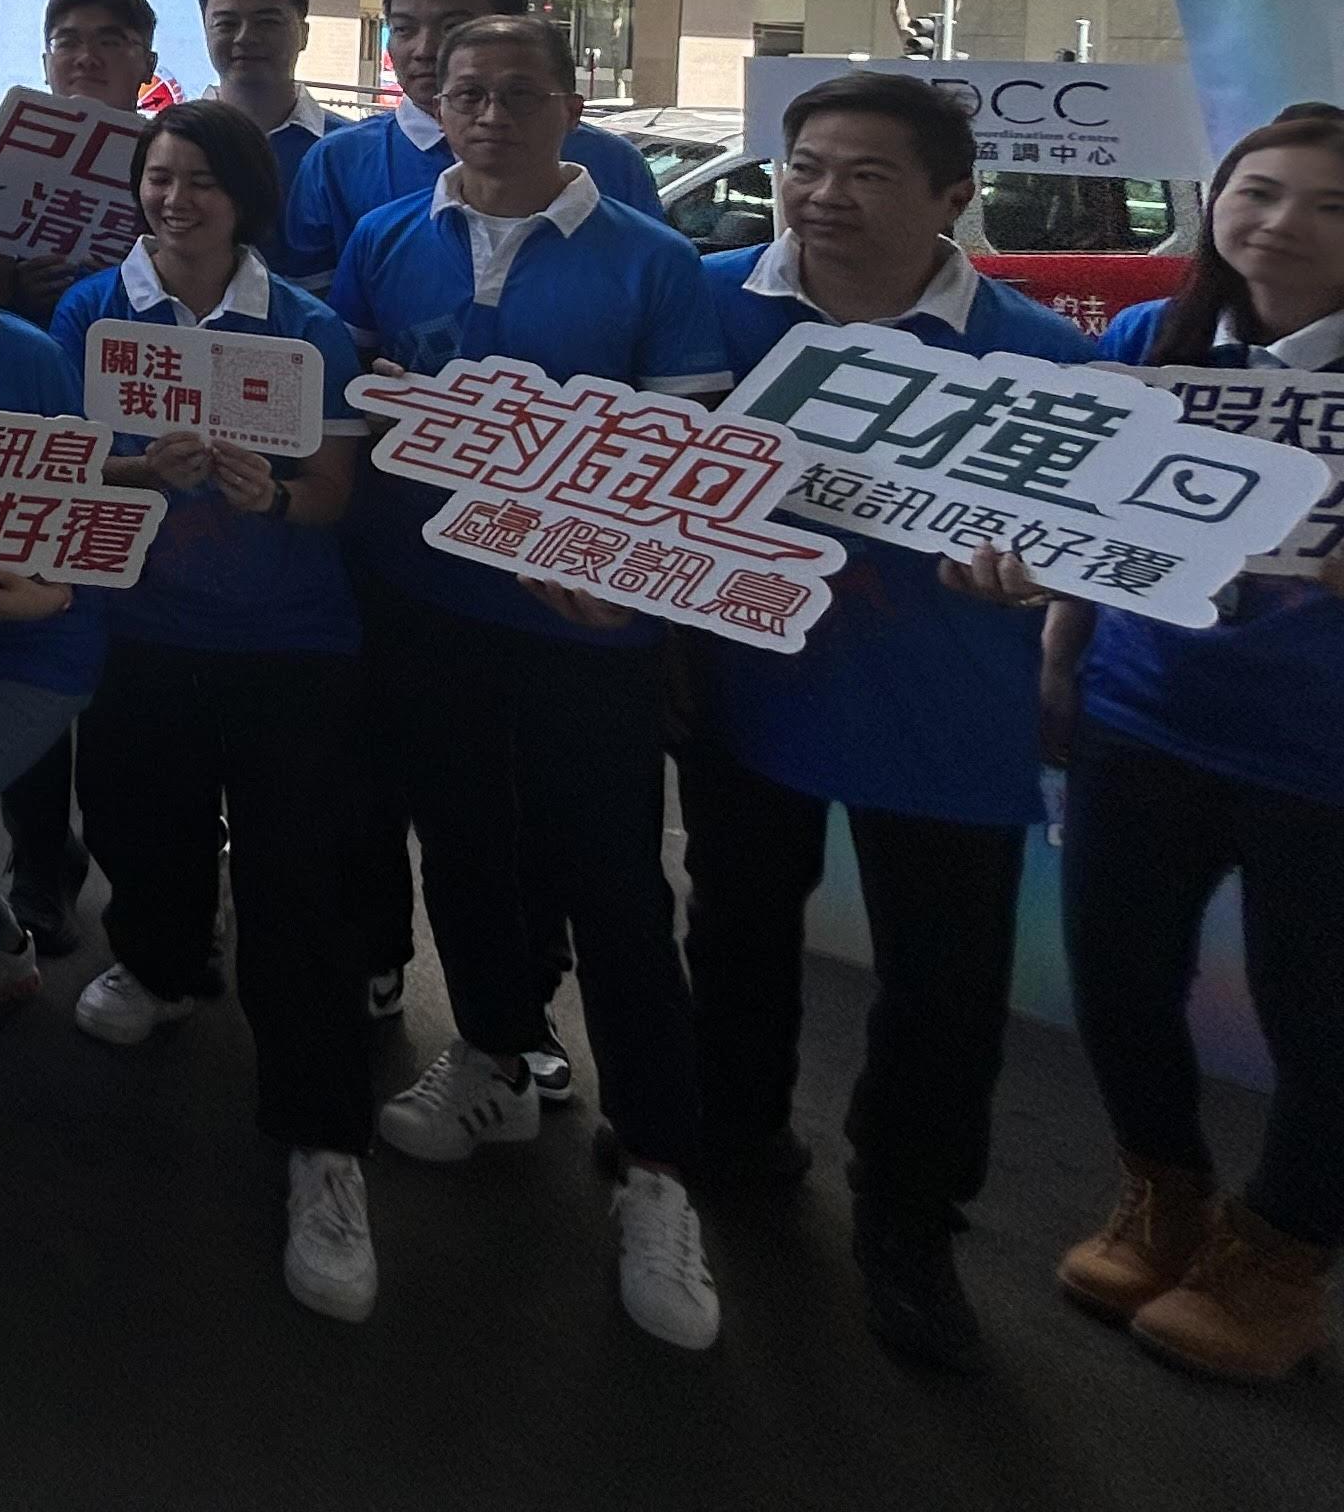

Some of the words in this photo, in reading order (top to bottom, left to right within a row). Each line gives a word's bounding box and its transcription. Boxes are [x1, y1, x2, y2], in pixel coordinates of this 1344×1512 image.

[928, 78, 1111, 127] DCC
[100, 338, 183, 383] 關注
[118, 380, 203, 426] 我們
[744, 345, 1133, 520] 白撞
[785, 461, 1186, 598] 短訊唔好覆
